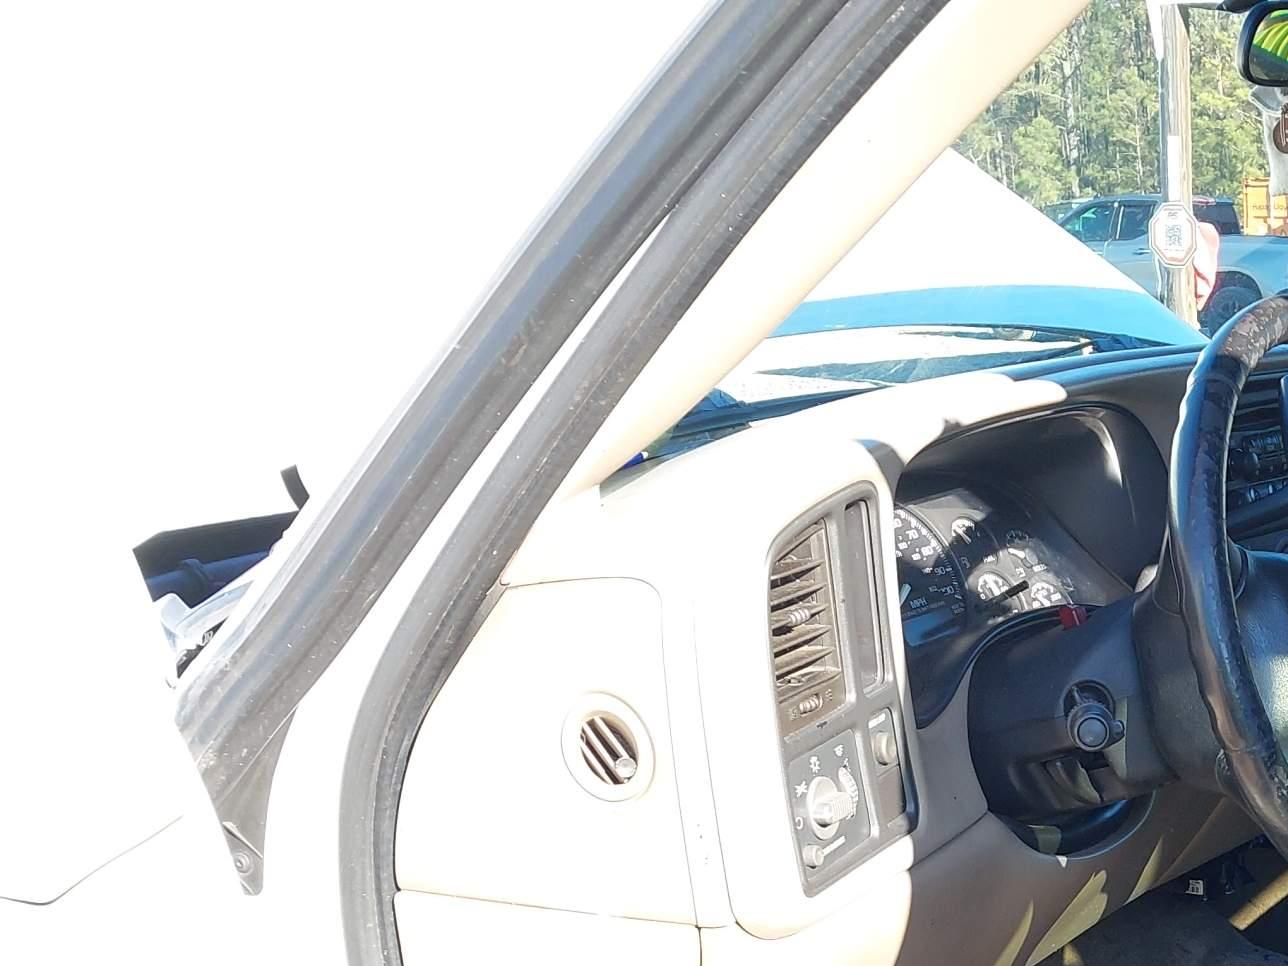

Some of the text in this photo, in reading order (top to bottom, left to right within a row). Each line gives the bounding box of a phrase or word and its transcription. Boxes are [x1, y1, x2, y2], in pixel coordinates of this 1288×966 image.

[905, 529, 918, 540] 70
[934, 566, 945, 576] 90
[909, 597, 928, 609] MPH
